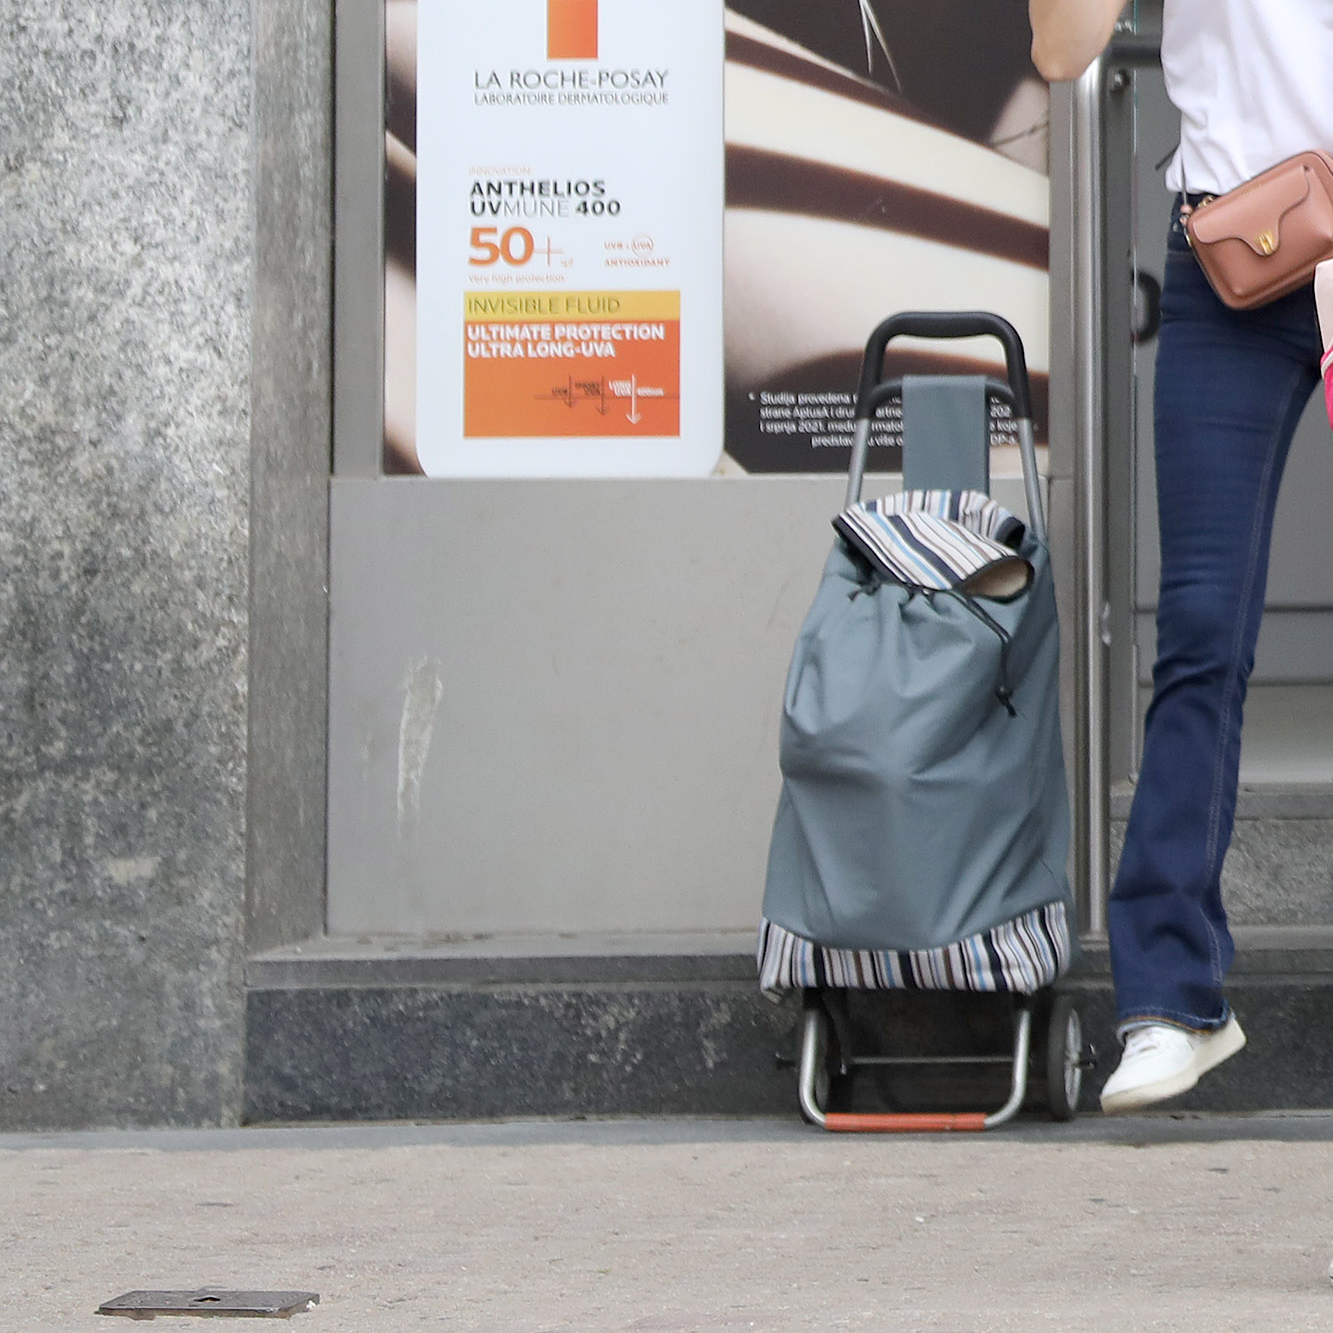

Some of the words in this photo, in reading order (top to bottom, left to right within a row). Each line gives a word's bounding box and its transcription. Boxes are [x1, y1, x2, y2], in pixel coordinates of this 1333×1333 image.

[474, 70, 502, 90] LA
[509, 69, 669, 90] ROCHE-POSAY
[469, 180, 606, 197] ANTHELIOS
[470, 200, 569, 217] UVMUNE
[576, 200, 621, 217] 400
[468, 298, 560, 314] INVISIBLE
[565, 298, 620, 314] FLUID
[467, 323, 551, 340] ULTIMATE
[555, 323, 665, 340] PROTECTION
[467, 341, 524, 358] ULTRA
